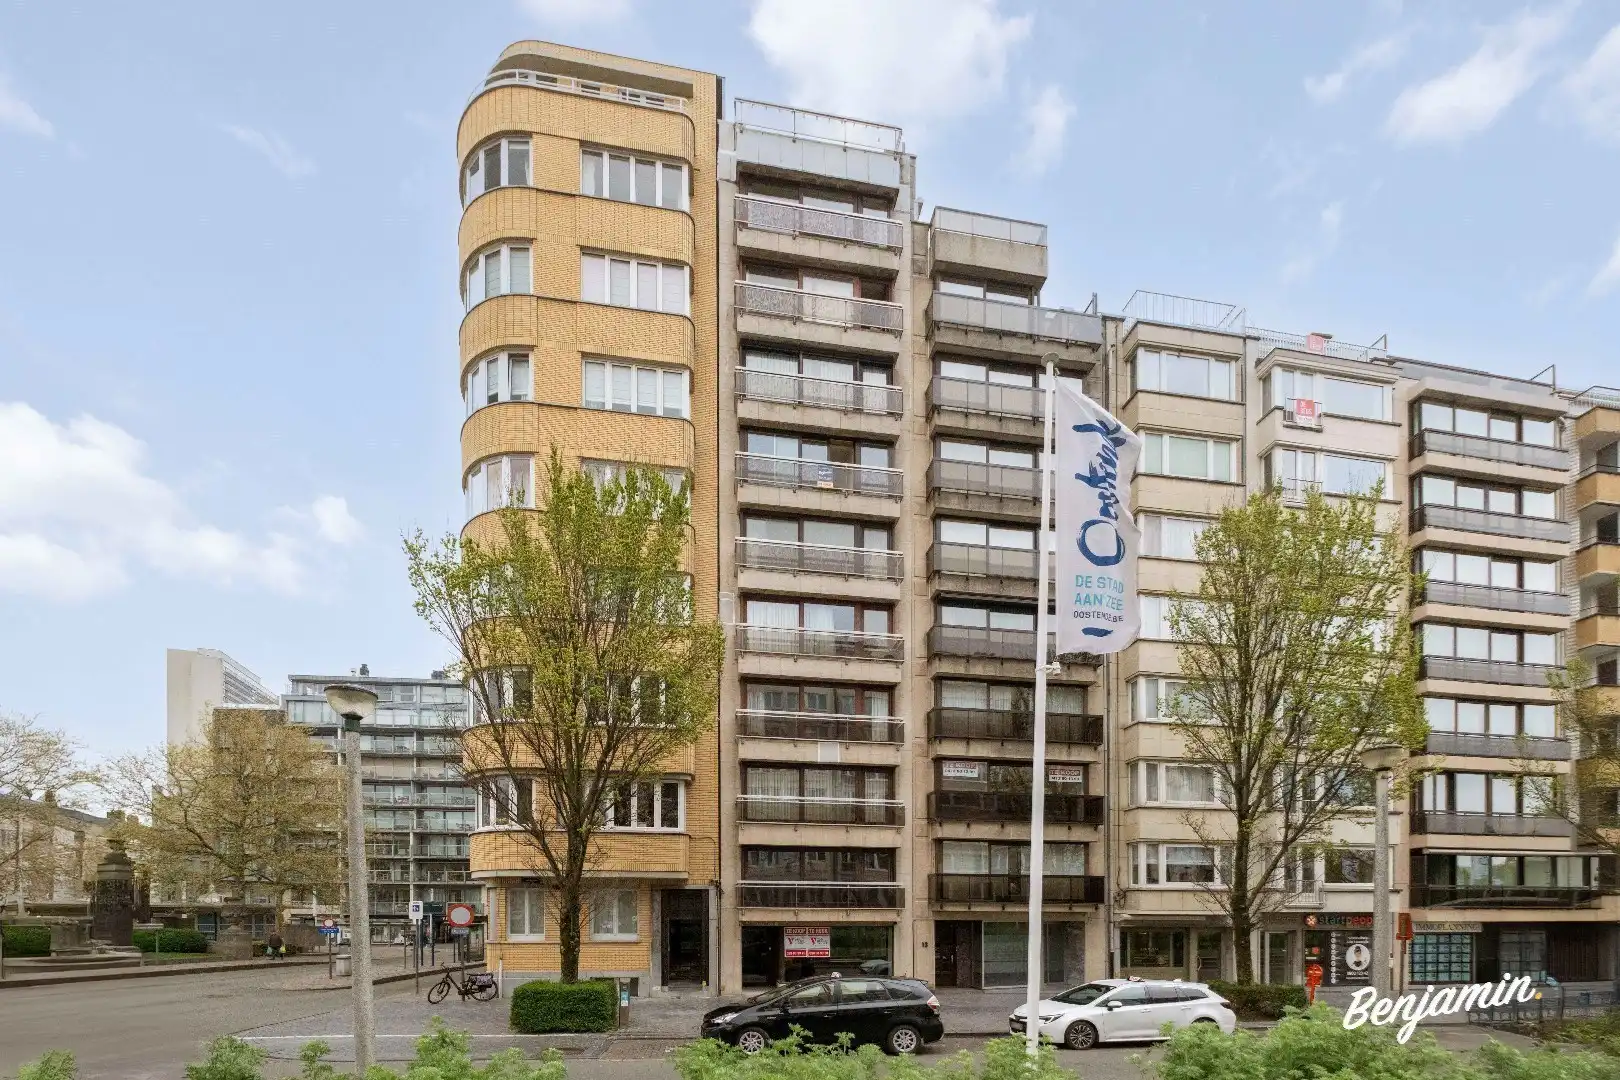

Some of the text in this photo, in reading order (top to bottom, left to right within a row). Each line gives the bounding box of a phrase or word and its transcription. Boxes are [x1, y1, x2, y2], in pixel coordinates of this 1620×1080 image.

[1075, 574, 1124, 594] DE STAD
[1074, 592, 1124, 611] AAN ZEE
[1319, 915, 1372, 926] startpeop
